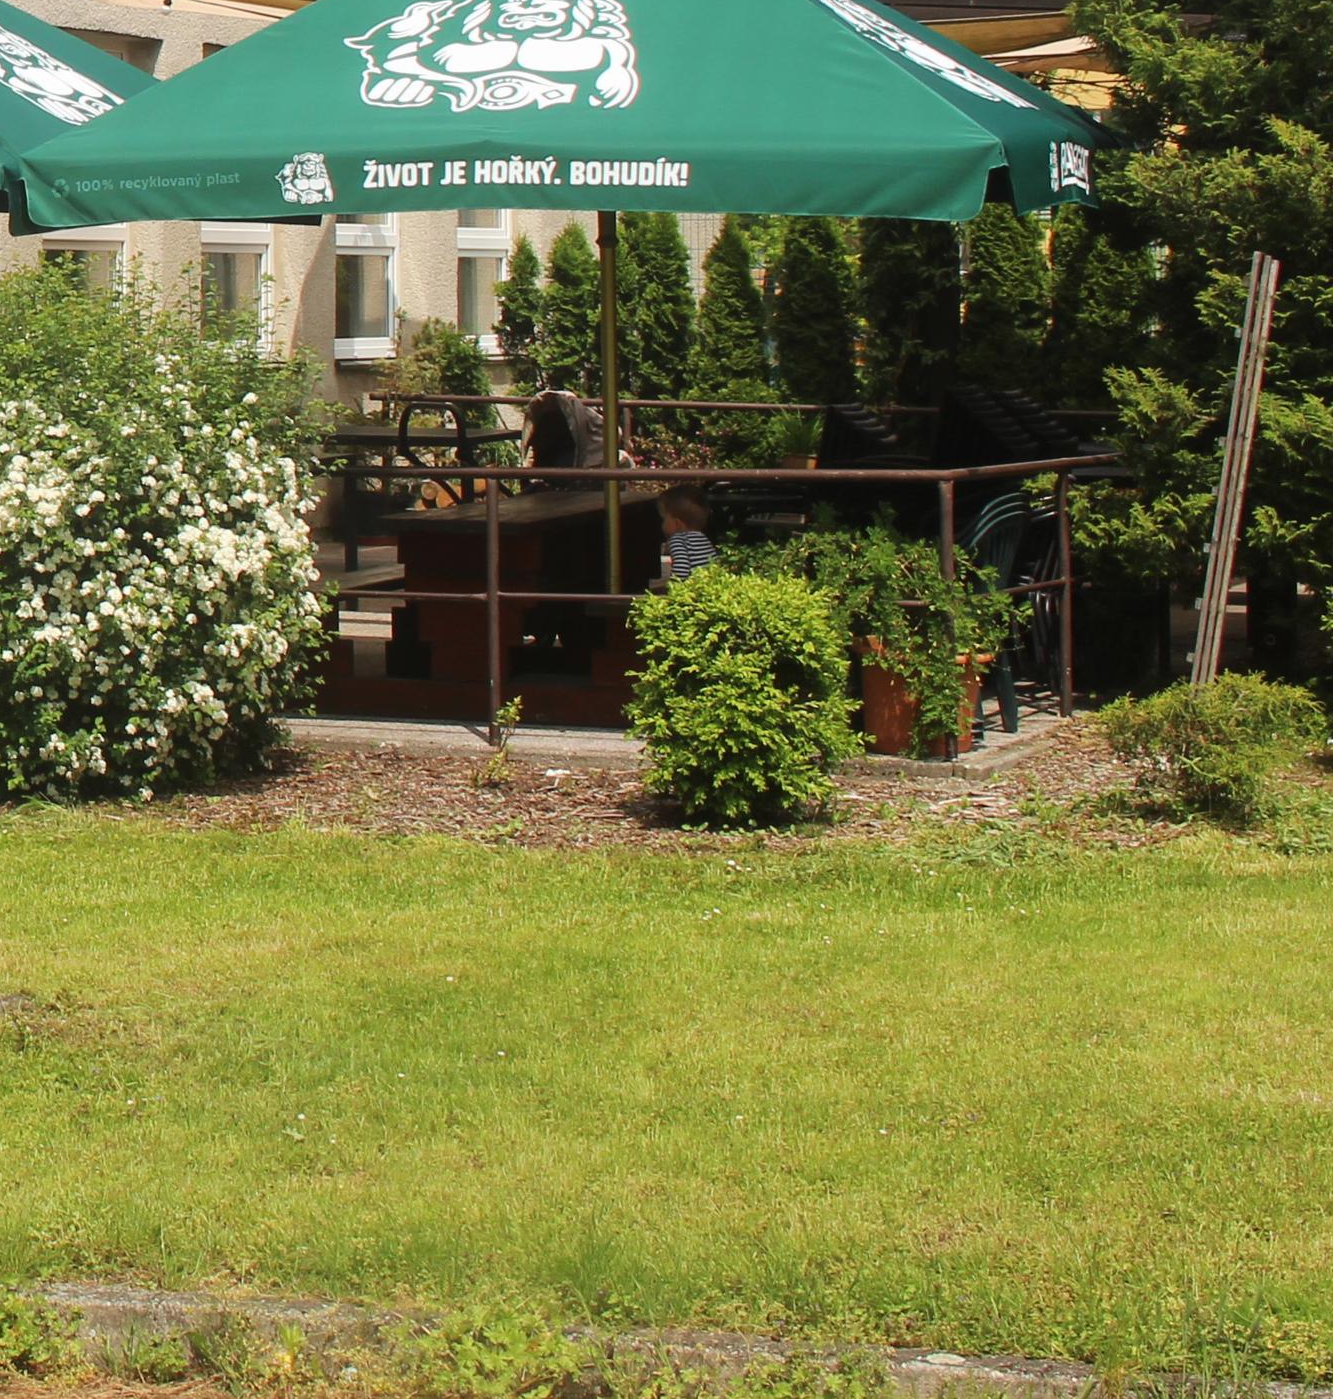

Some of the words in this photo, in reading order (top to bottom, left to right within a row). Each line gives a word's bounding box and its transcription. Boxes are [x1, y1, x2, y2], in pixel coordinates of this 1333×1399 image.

[75, 178, 115, 193] 100%
[119, 173, 202, 191] recyklovaný
[206, 172, 241, 187] plast
[363, 159, 434, 189] ŽIVOT
[440, 161, 467, 186] JE
[473, 155, 562, 186] HOŘKÝ.
[569, 157, 690, 188] BOHUDÍK!
